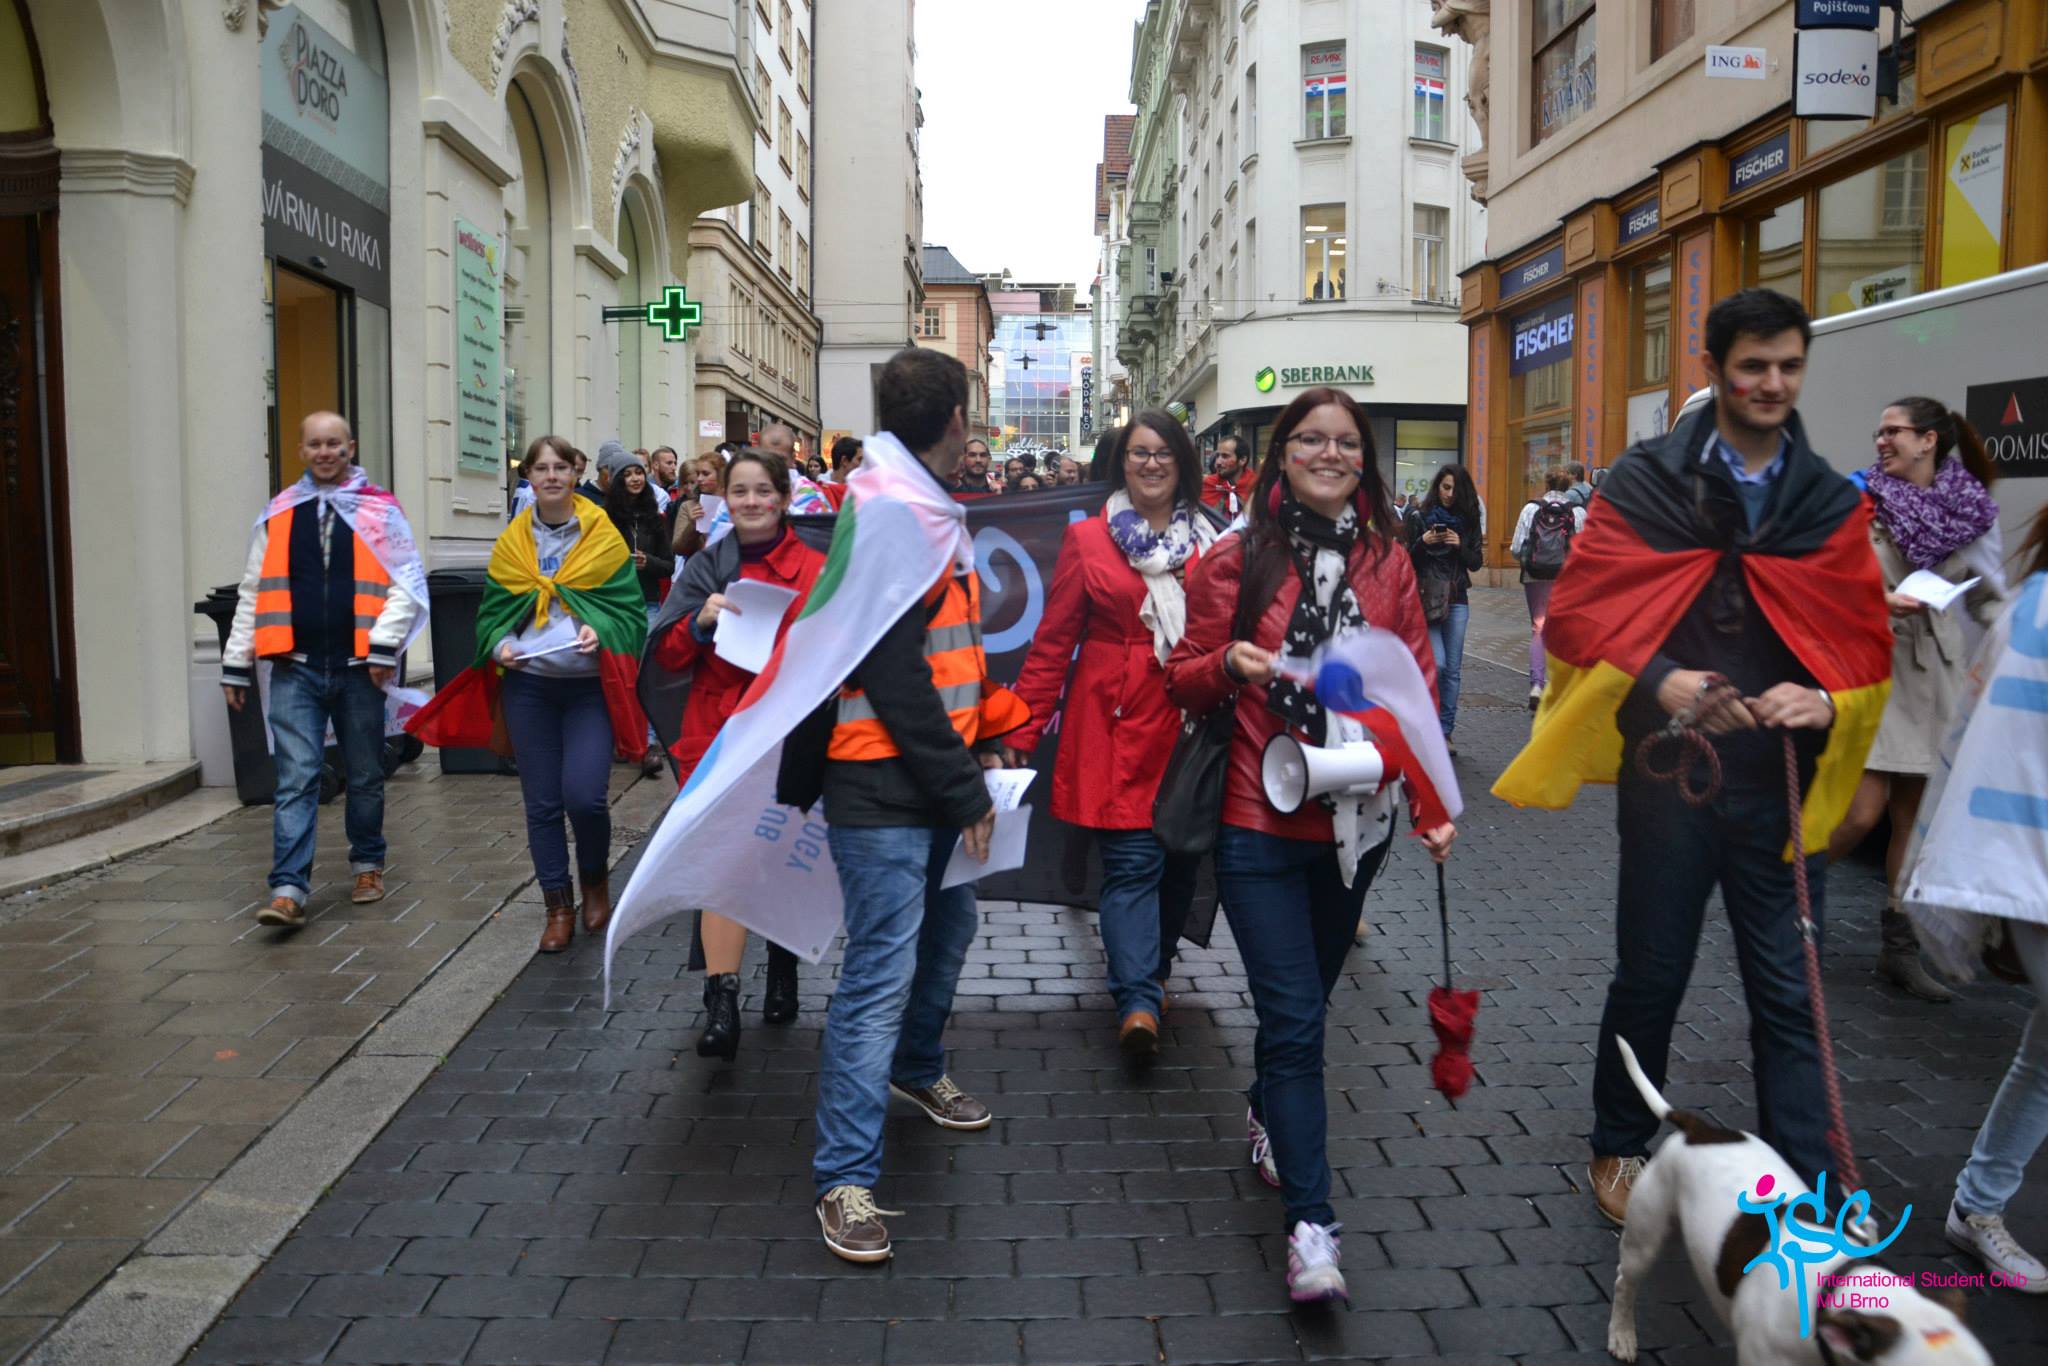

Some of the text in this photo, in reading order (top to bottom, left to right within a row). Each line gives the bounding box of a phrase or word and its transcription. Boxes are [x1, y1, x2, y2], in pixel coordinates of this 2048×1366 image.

[296, 23, 348, 97] PIAZZA
[1711, 55, 1741, 69] ING
[1803, 68, 1871, 87] sodexo
[1735, 148, 1785, 185] FISCHER
[262, 177, 382, 271] VÁRNA U RAKA
[1523, 261, 1549, 285] FISCHER
[1281, 365, 1374, 383] SBERBANK
[1984, 432, 2048, 461] OOMIS
